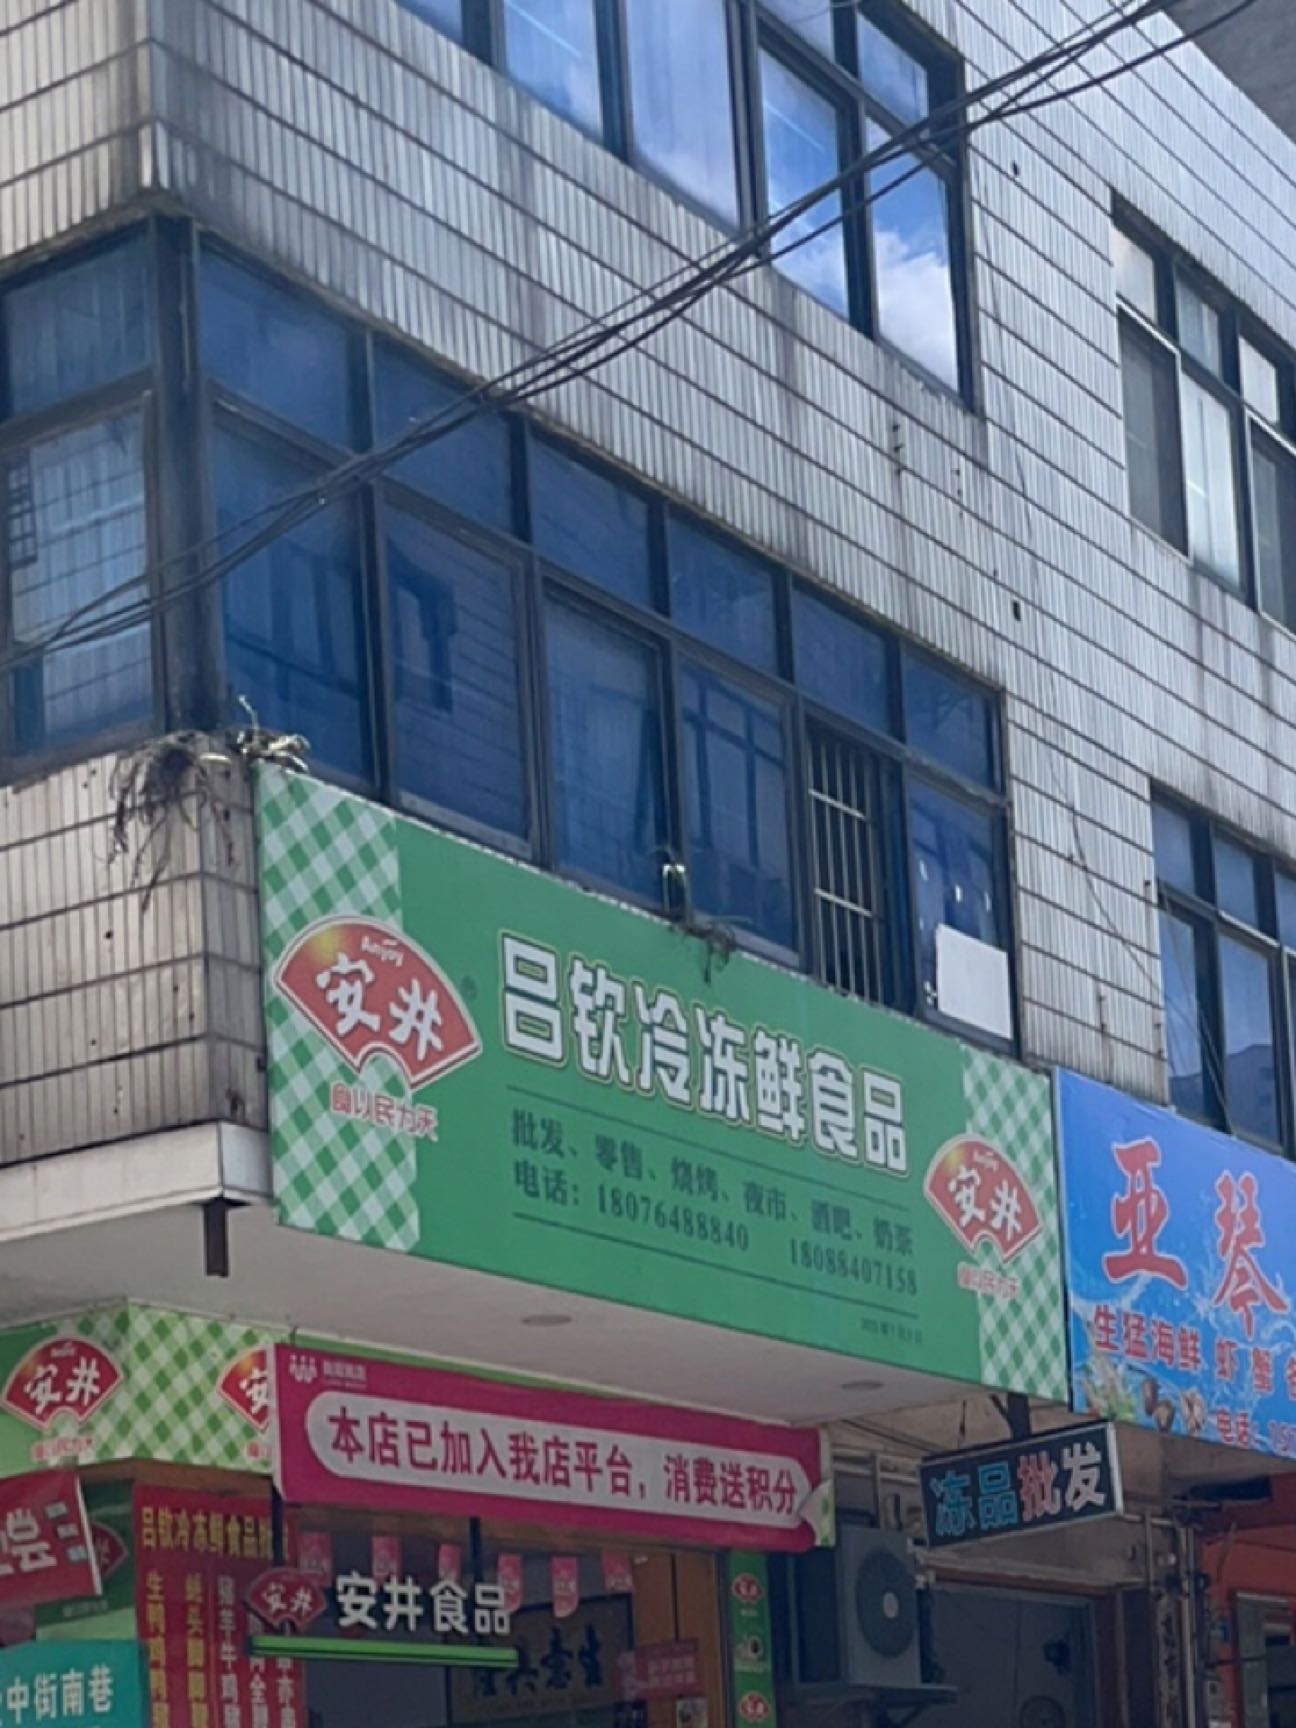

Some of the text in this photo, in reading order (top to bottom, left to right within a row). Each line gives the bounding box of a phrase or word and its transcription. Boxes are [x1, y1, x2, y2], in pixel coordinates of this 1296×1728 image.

[315, 952, 444, 1062] 安井
[502, 936, 907, 1172] 吕钦冷冻鲜食品
[947, 1165, 1022, 1242] 安井
[23, 1356, 100, 1415] 安井
[261, 1580, 315, 1617] 安井
[335, 1569, 511, 1636] 安井食品
[0, 1664, 114, 1726] 中街南巷
